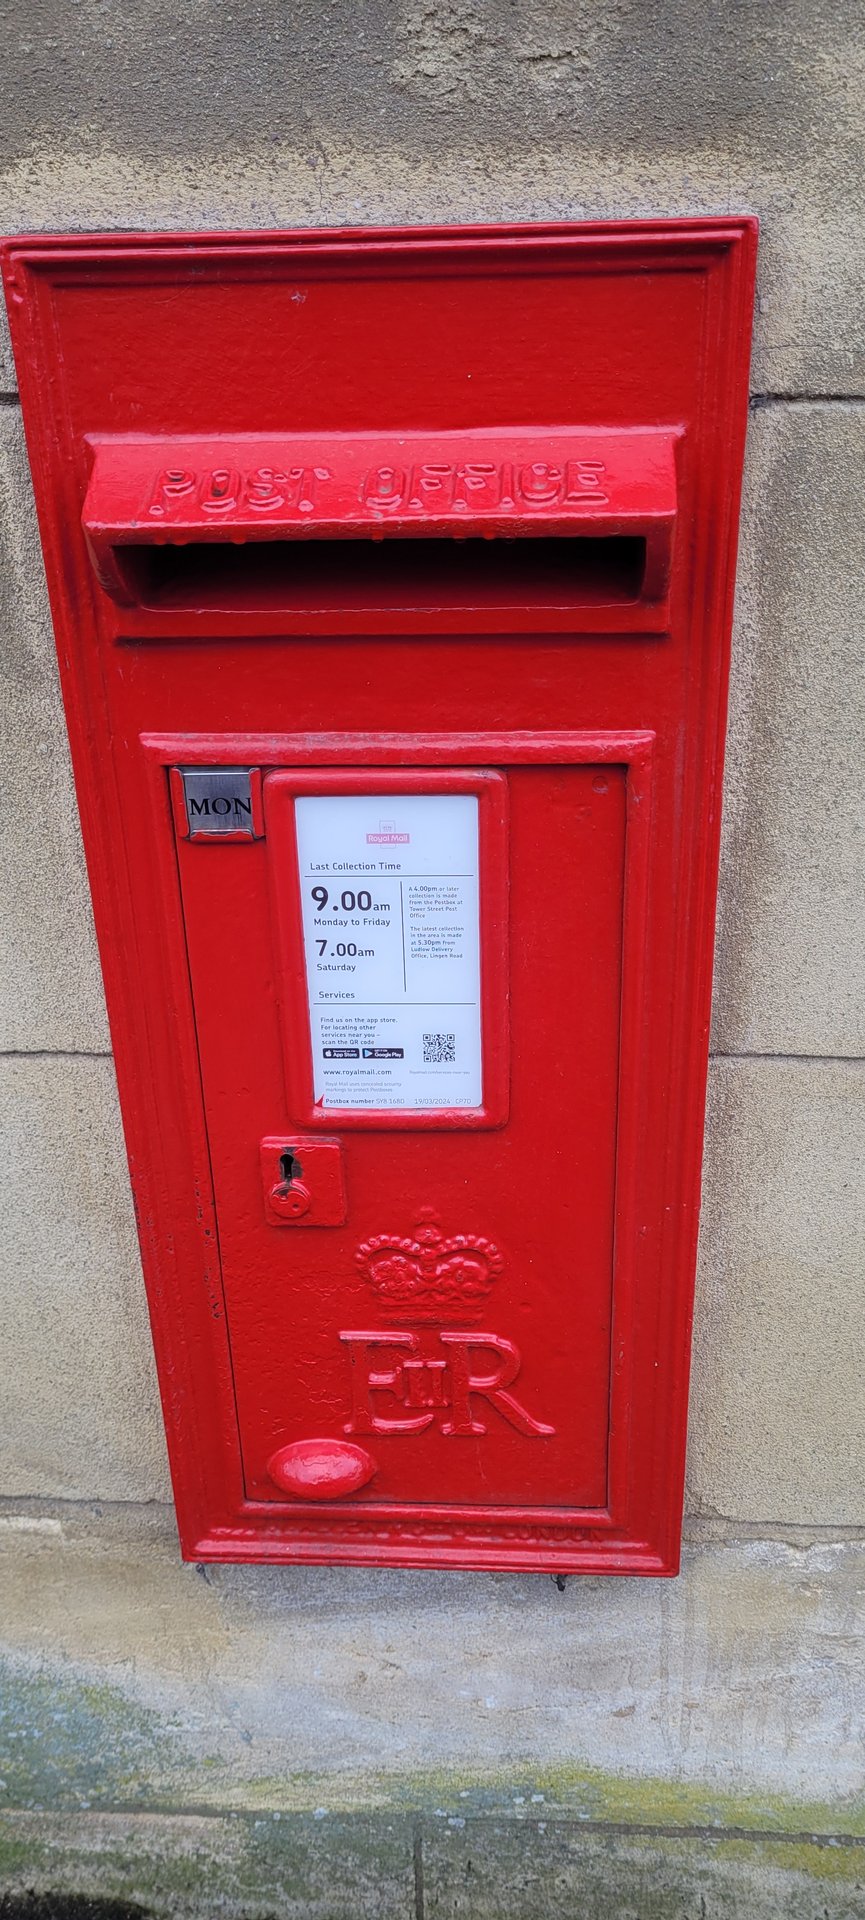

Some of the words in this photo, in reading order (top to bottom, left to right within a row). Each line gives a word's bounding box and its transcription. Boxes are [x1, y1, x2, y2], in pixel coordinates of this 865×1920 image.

[149, 467, 332, 516] POST
[364, 460, 610, 512] OFFICE
[188, 798, 252, 816] MON
[368, 834, 390, 842] Royal
[391, 834, 408, 842] Mail
[310, 862, 330, 870] Last
[332, 862, 376, 870] Collection
[378, 862, 402, 870] Time
[311, 886, 391, 912] 9.00am
[313, 918, 348, 927] Monday
[363, 918, 391, 927] Friday
[315, 939, 375, 957] 7.00am
[316, 963, 356, 972] Saturday
[318, 991, 355, 999] Services
